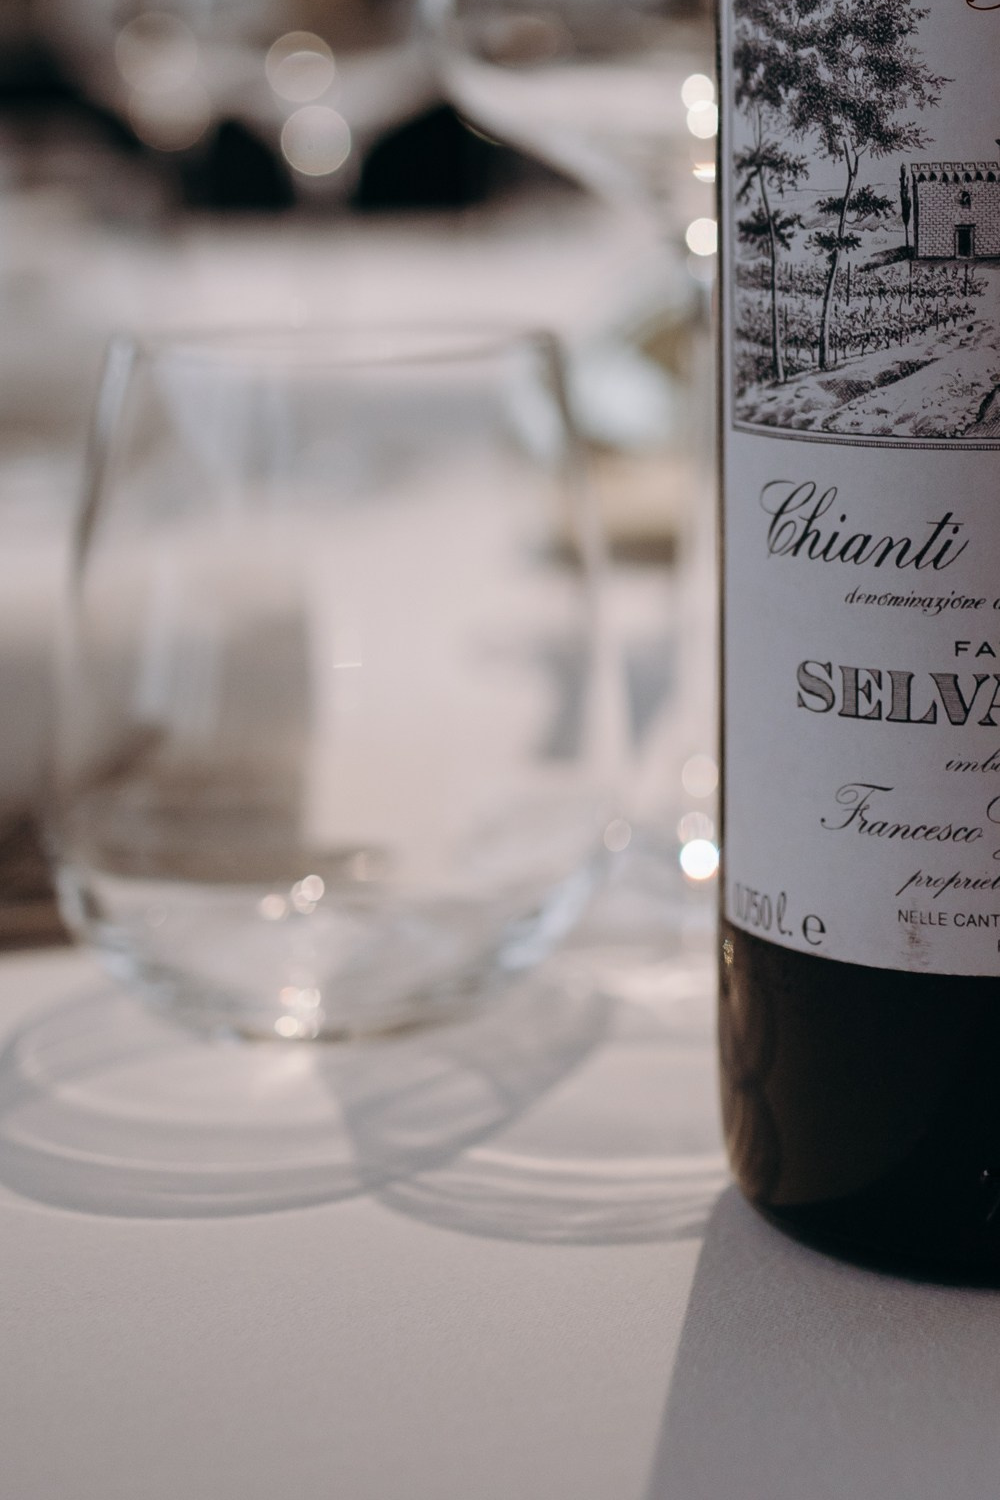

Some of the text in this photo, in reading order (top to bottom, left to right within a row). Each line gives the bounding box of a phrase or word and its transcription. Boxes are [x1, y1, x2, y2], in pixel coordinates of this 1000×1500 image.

[760, 479, 970, 571] Chianti
[844, 586, 987, 615] denominazione
[819, 781, 983, 844] Francesco
[897, 909, 948, 927] NELLE
